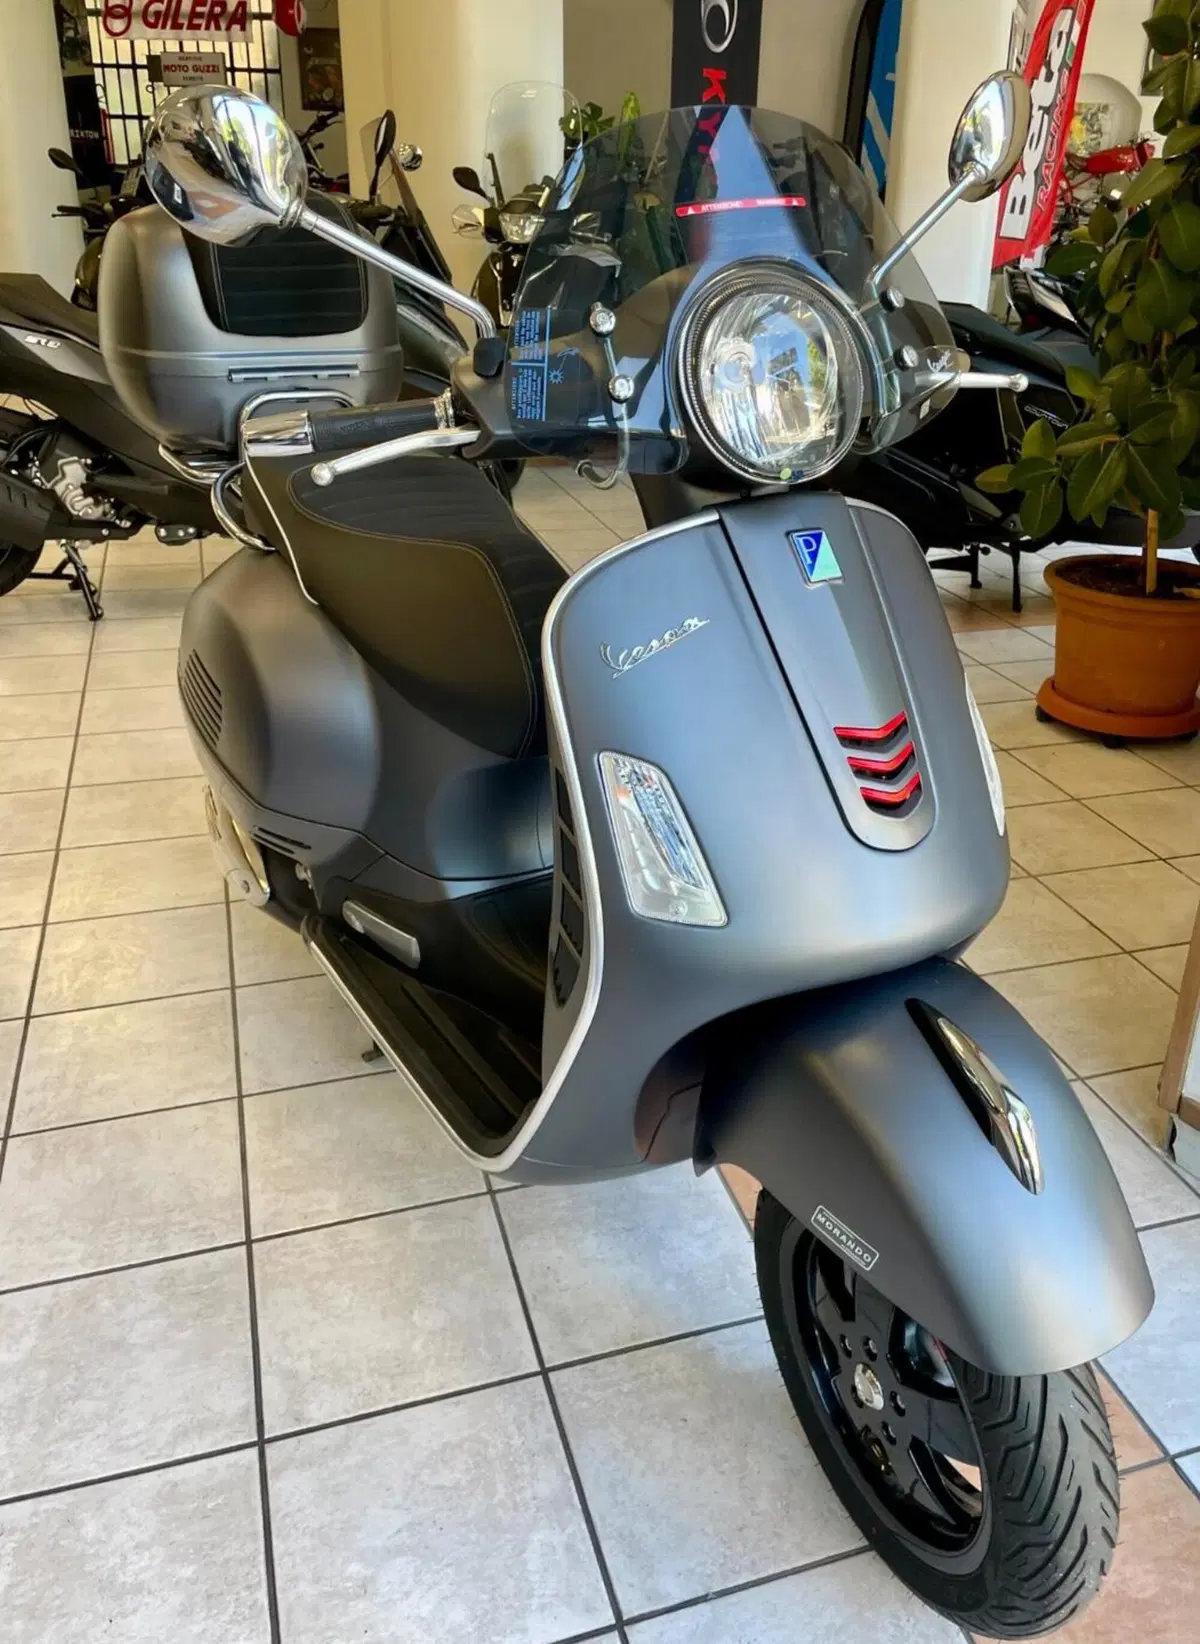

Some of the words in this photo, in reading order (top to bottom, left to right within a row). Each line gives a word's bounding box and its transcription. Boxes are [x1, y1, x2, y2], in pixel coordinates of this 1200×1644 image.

[142, 0, 248, 32] GILERA
[163, 64, 190, 73] MOTO
[192, 64, 220, 73] GUZZI
[1000, 9, 1073, 240] Beta
[1037, 68, 1069, 211] RACING
[795, 536, 817, 565] P
[600, 617, 710, 679] Vespa
[815, 1213, 872, 1263] MORANDO
